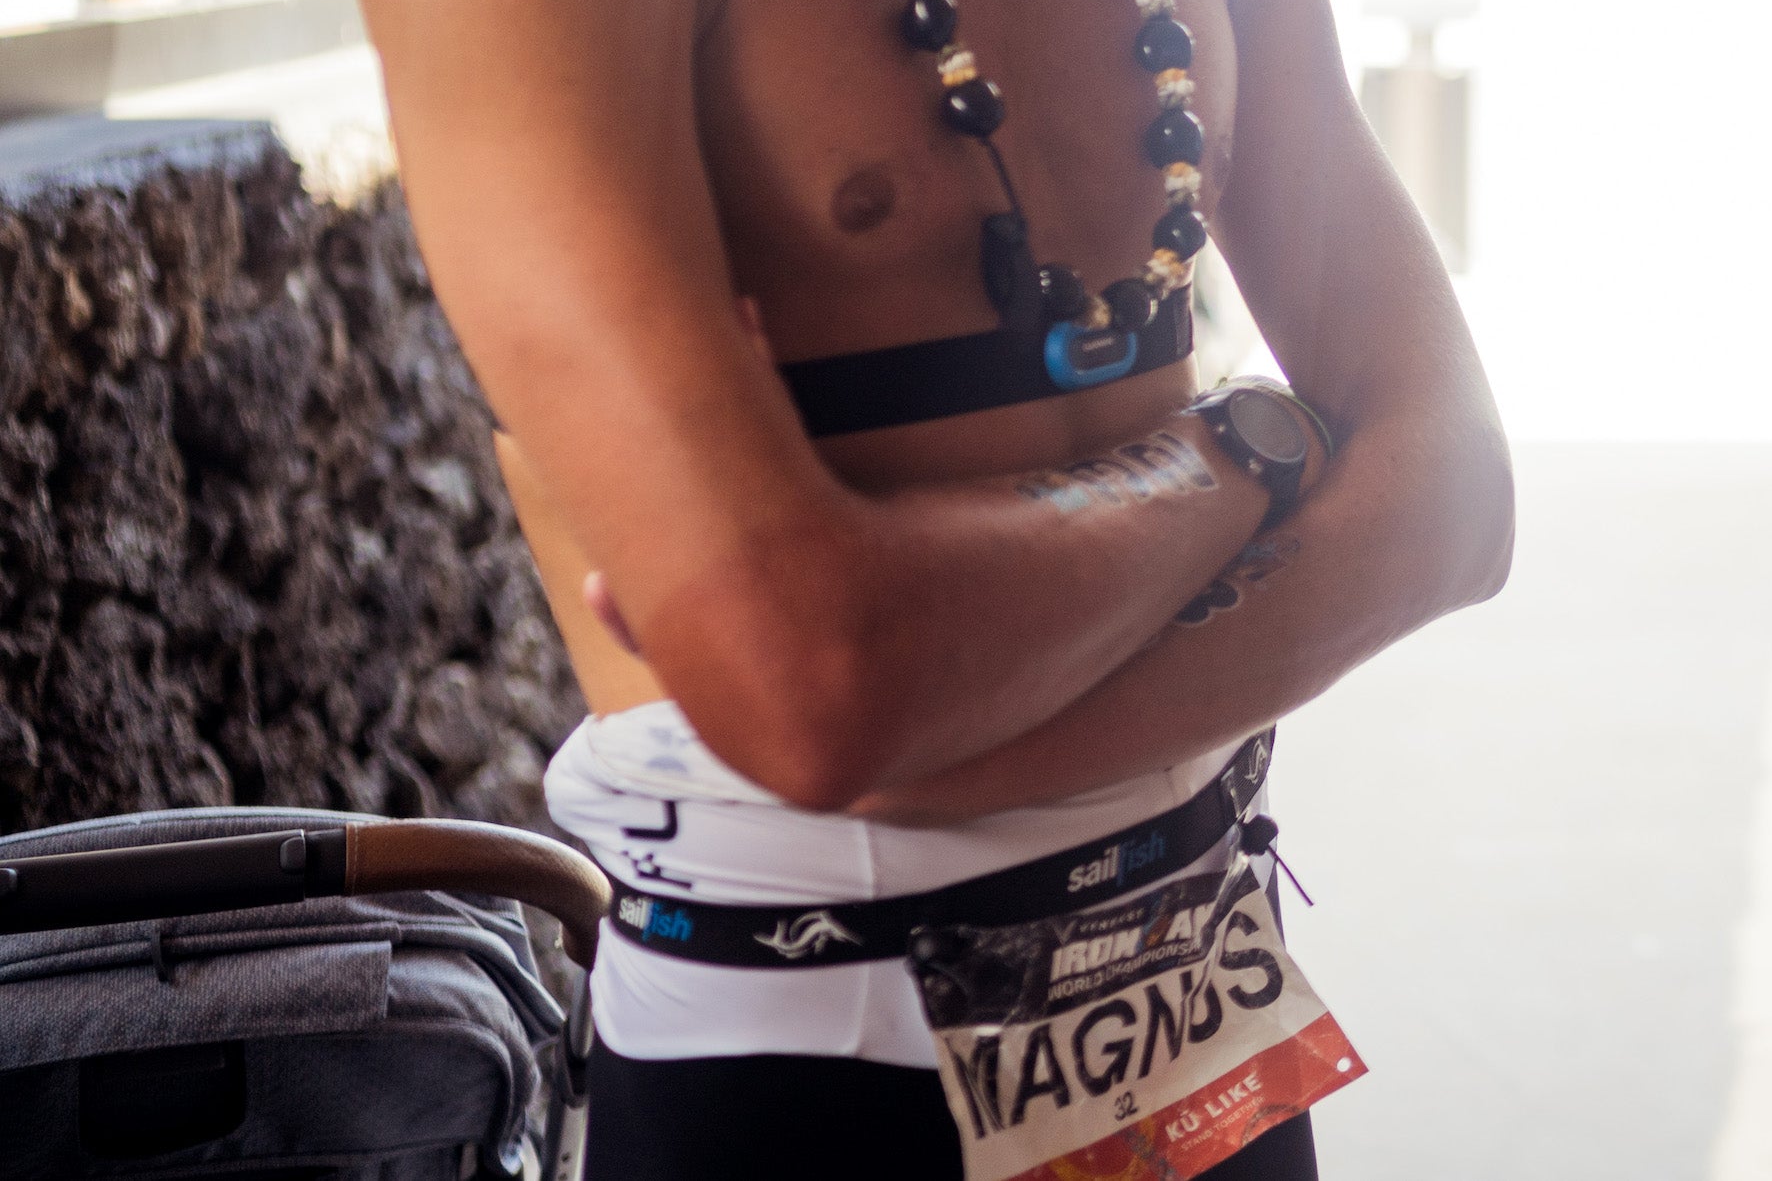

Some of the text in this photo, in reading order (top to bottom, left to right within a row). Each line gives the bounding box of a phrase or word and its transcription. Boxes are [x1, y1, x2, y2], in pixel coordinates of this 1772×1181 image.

[1067, 830, 1164, 893] sailfish
[619, 897, 693, 940] sailfish
[1048, 973, 1104, 1001] WORLD
[1114, 1091, 1139, 1121] 32
[1204, 1071, 1262, 1118] LIKE
